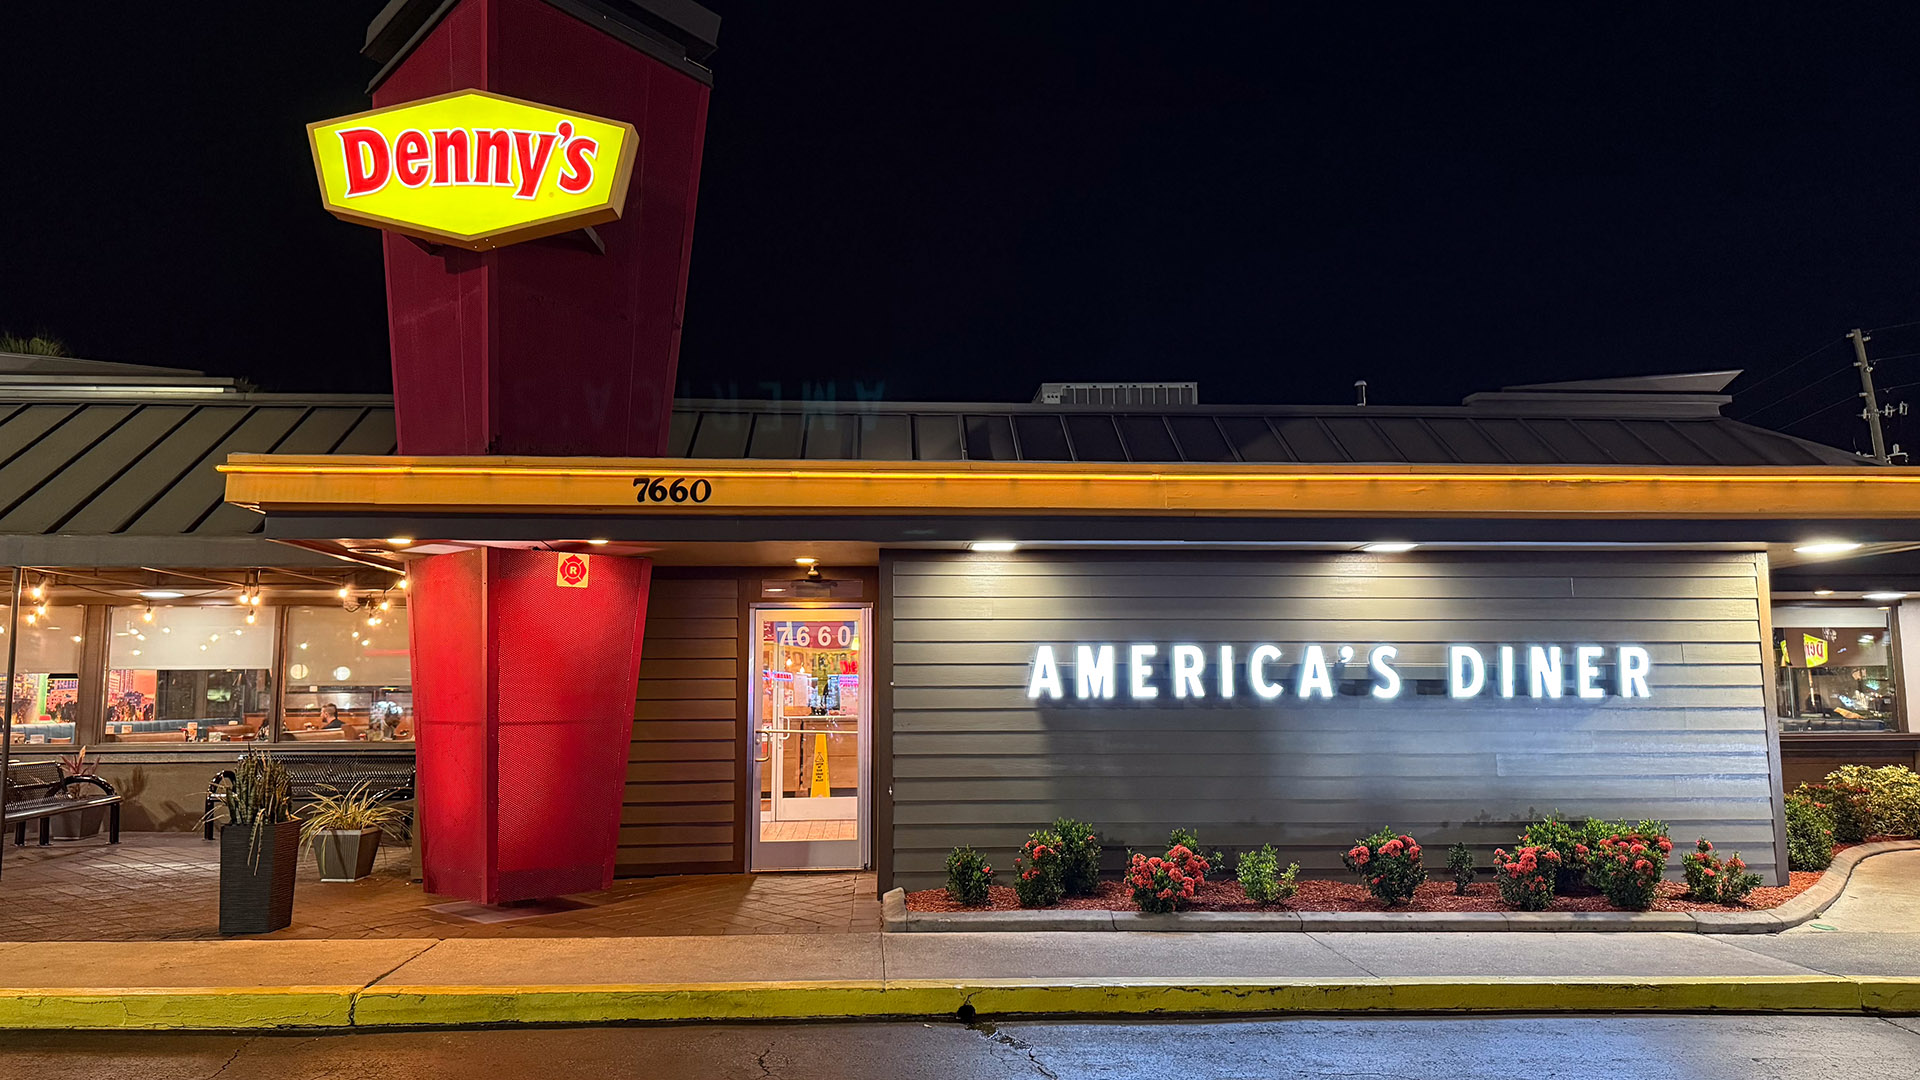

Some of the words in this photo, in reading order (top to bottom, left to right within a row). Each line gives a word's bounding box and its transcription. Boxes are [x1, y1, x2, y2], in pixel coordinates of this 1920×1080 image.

[335, 120, 598, 200] Denny's
[633, 478, 712, 503] 7660
[570, 566, 577, 575] R
[777, 626, 851, 647] 7660
[1027, 644, 1403, 700] AMERICA'S
[1449, 645, 1654, 700] DINER
